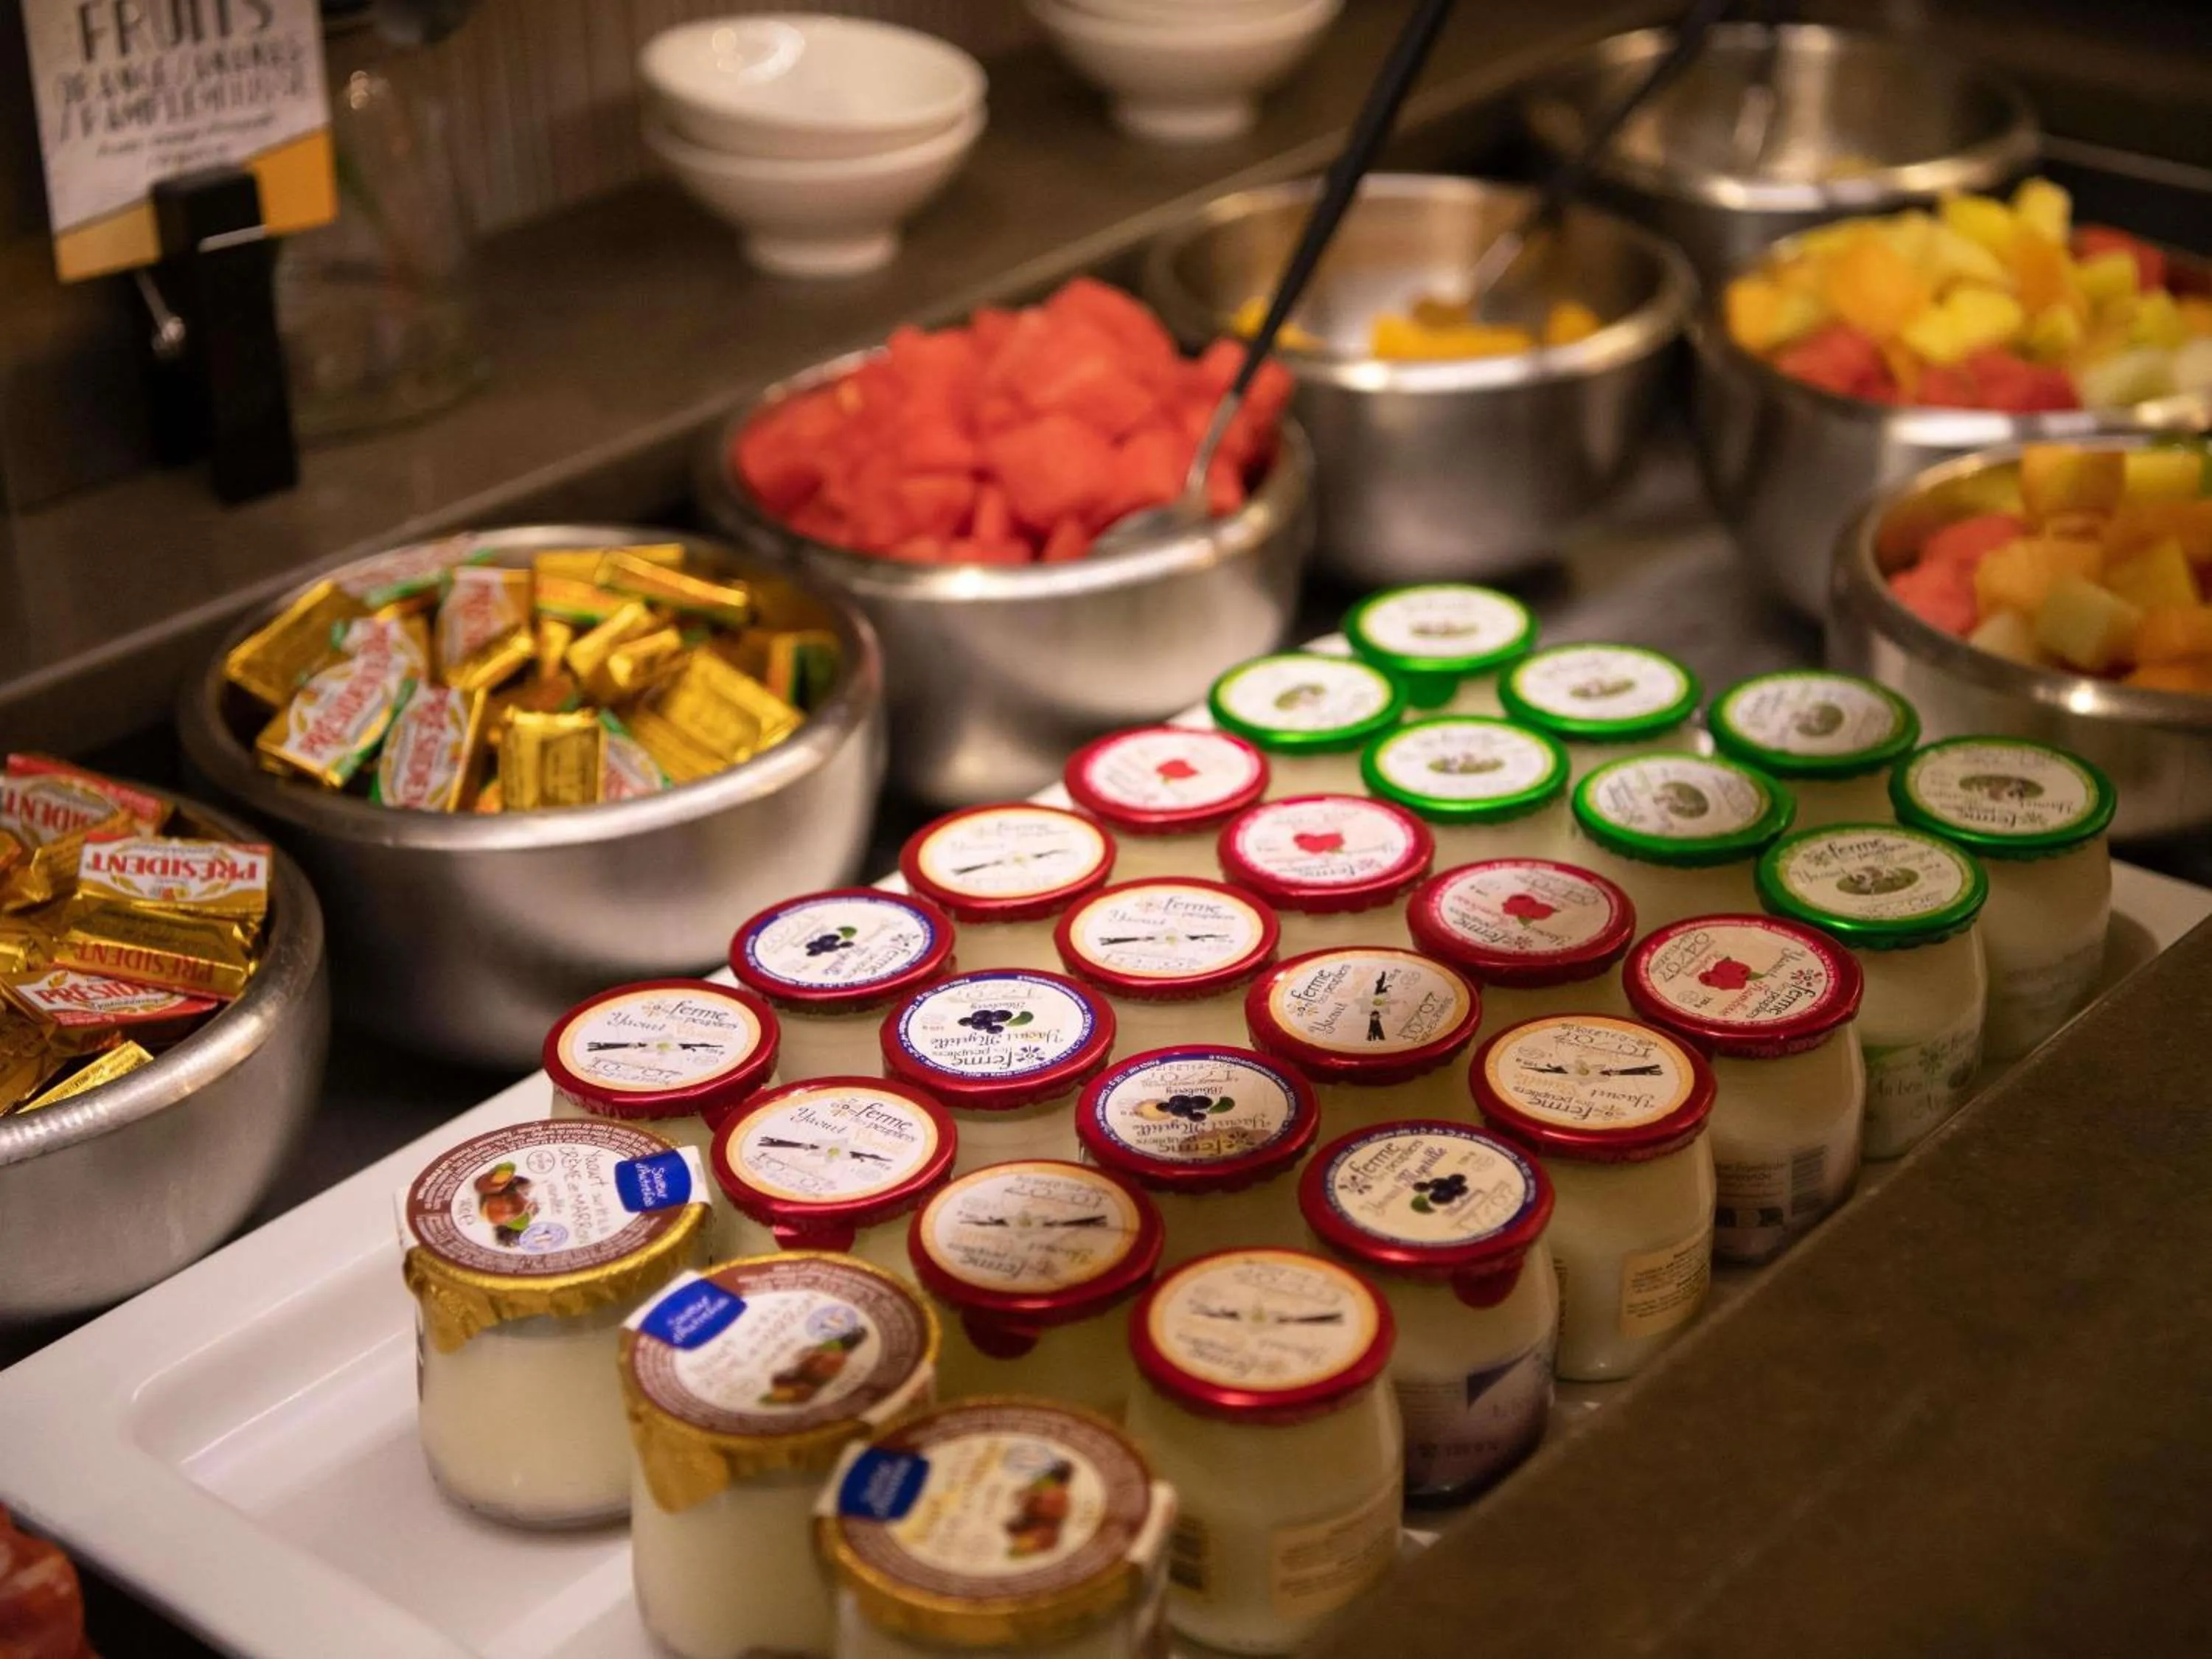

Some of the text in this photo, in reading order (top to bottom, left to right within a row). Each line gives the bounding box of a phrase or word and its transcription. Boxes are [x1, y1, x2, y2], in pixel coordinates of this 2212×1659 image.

[1290, 968, 1332, 1006] ferme
[668, 999, 731, 1020] ferme
[1769, 984, 1817, 1016] ferme
[606, 1010, 667, 1032] Yaourt
[1006, 1028, 1065, 1045] Yaourt
[951, 1048, 1013, 1071] ferme
[1526, 1097, 1594, 1121] ferme
[1590, 1088, 1656, 1109] Yaourt
[789, 1106, 849, 1135] Yaourt
[858, 1102, 915, 1131] ferme
[1349, 1141, 1401, 1180] ferme
